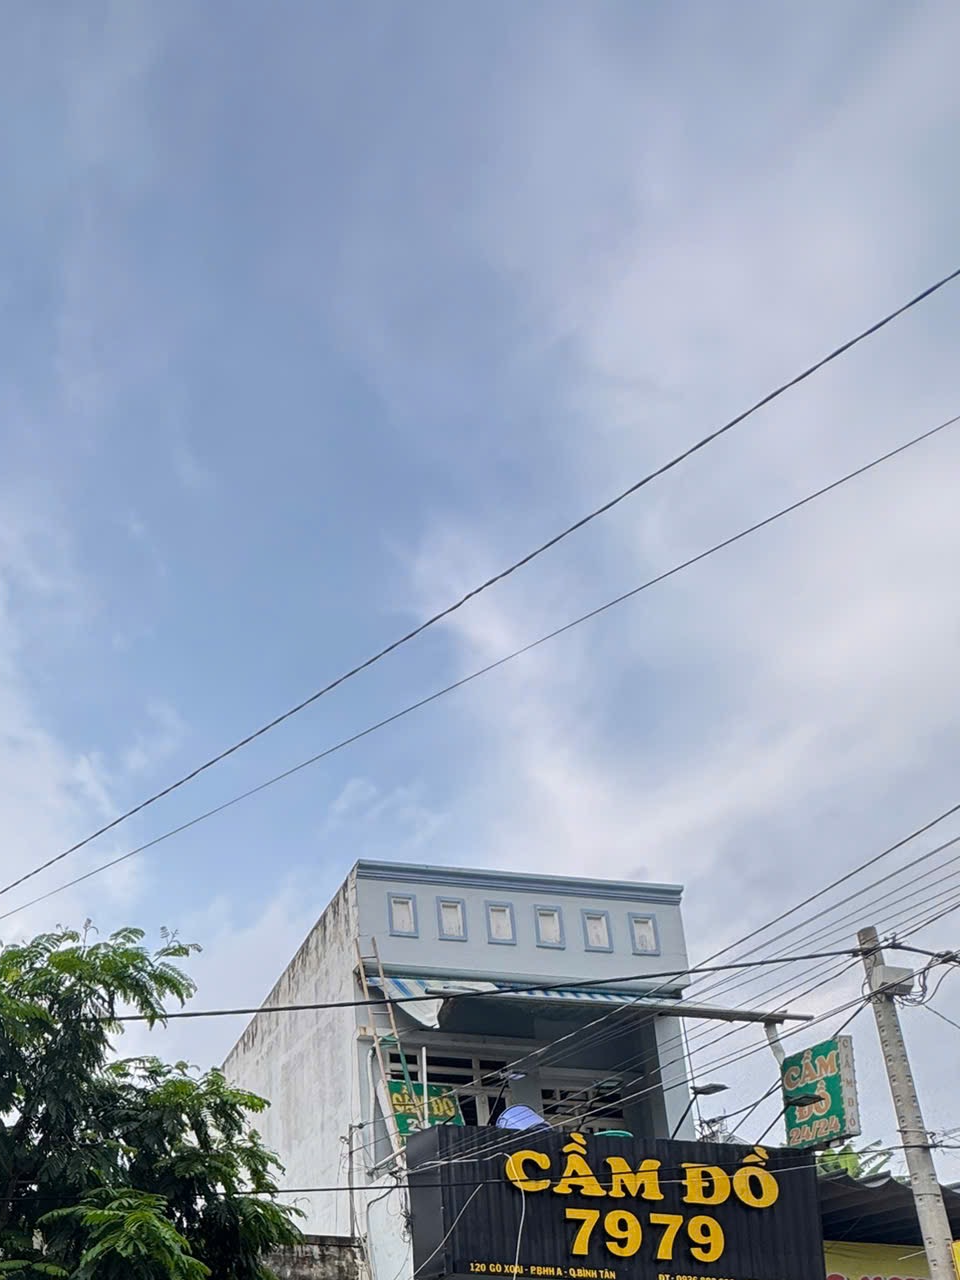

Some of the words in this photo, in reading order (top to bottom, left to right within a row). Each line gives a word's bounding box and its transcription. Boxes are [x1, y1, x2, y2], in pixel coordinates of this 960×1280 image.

[783, 1050, 838, 1090] CẦM
[789, 1116, 840, 1145] 24/24
[505, 1132, 664, 1201] CẦM
[681, 1146, 779, 1208] ĐỒ
[470, 1262, 486, 1272] 120
[599, 1269, 616, 1280] TÂN
